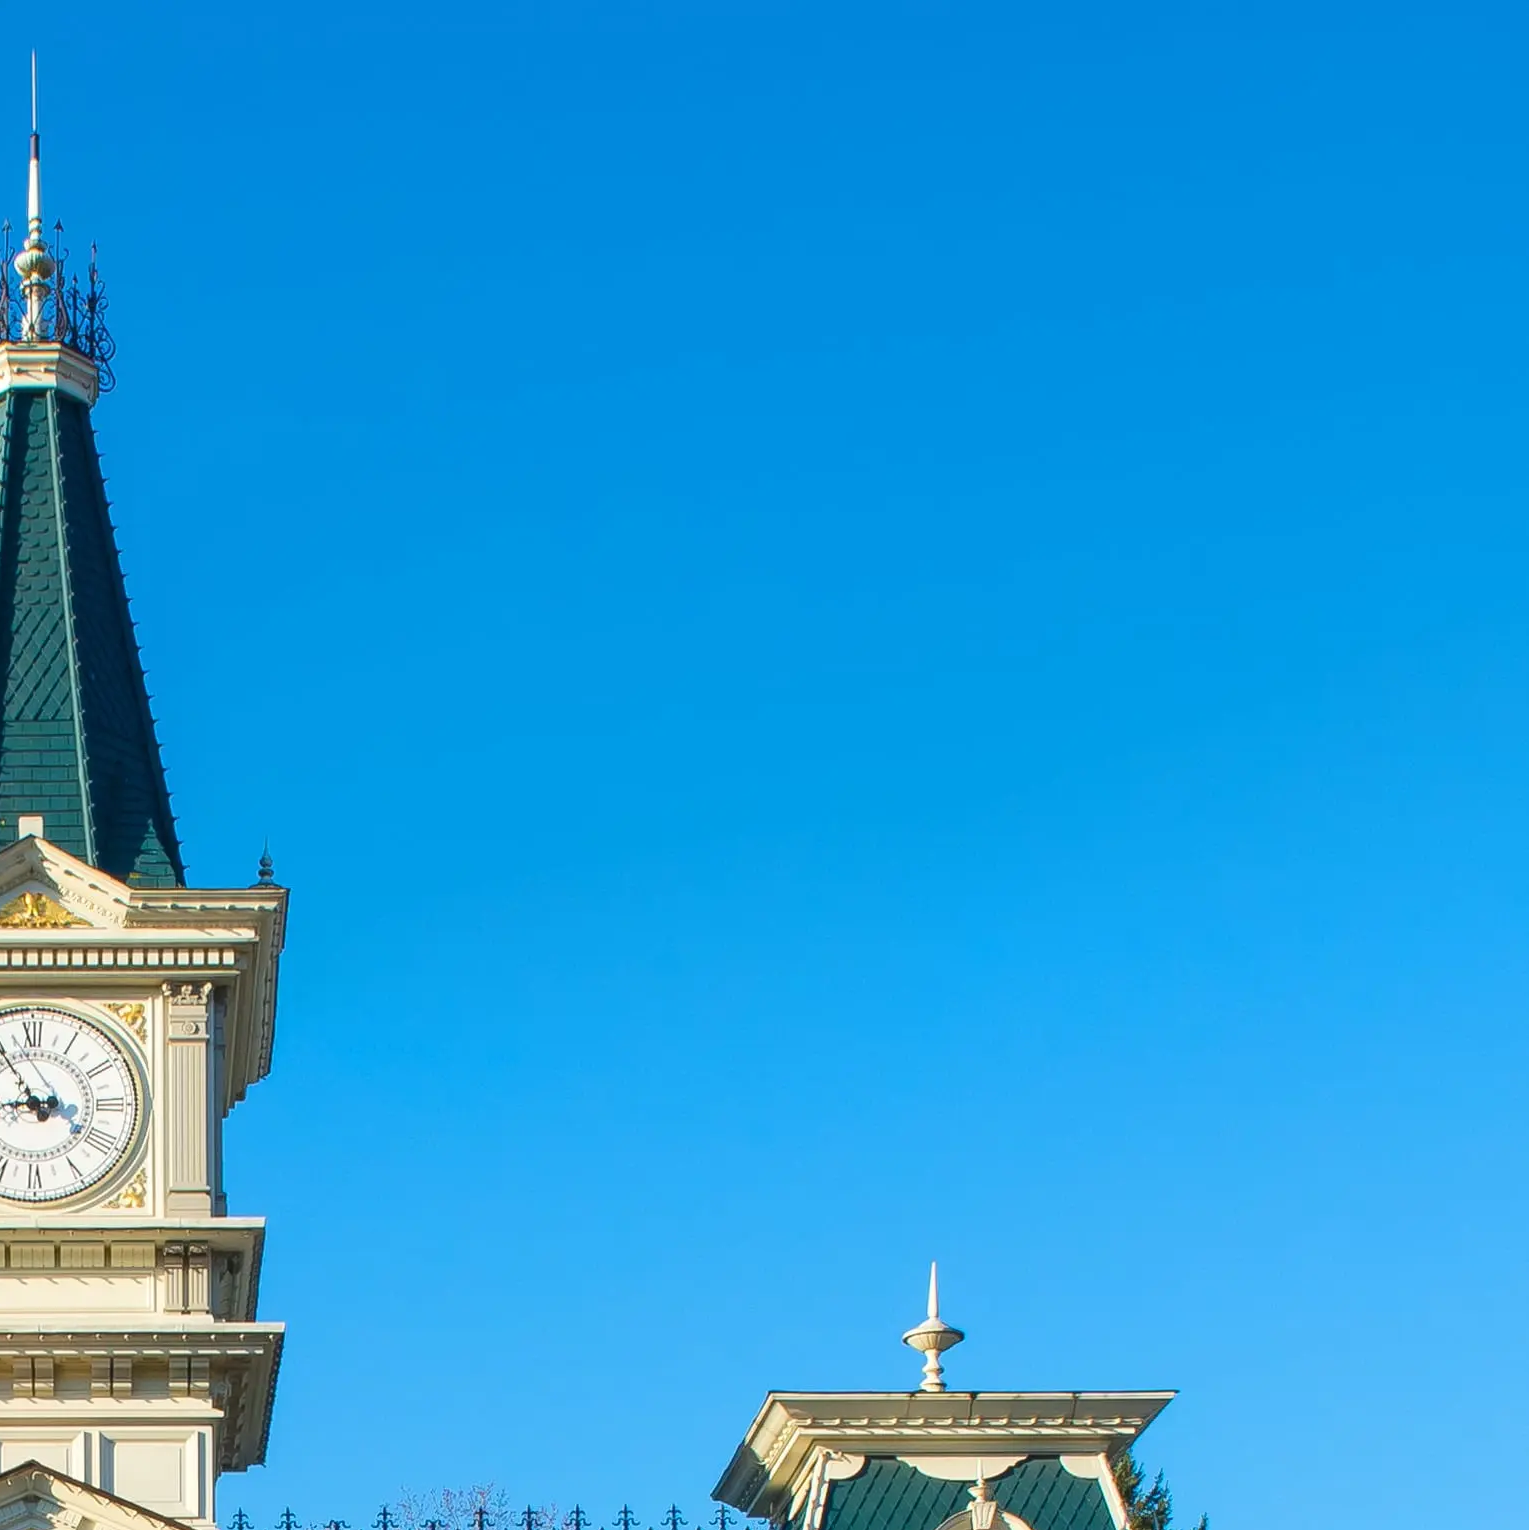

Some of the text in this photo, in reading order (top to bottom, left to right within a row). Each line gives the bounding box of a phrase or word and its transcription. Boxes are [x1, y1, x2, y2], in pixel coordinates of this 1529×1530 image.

[22, 1021, 43, 1048] XII
[86, 1059, 113, 1078] II
[96, 1097, 124, 1112] III
[27, 1163, 43, 1189] VI
[65, 1155, 83, 1180] V
